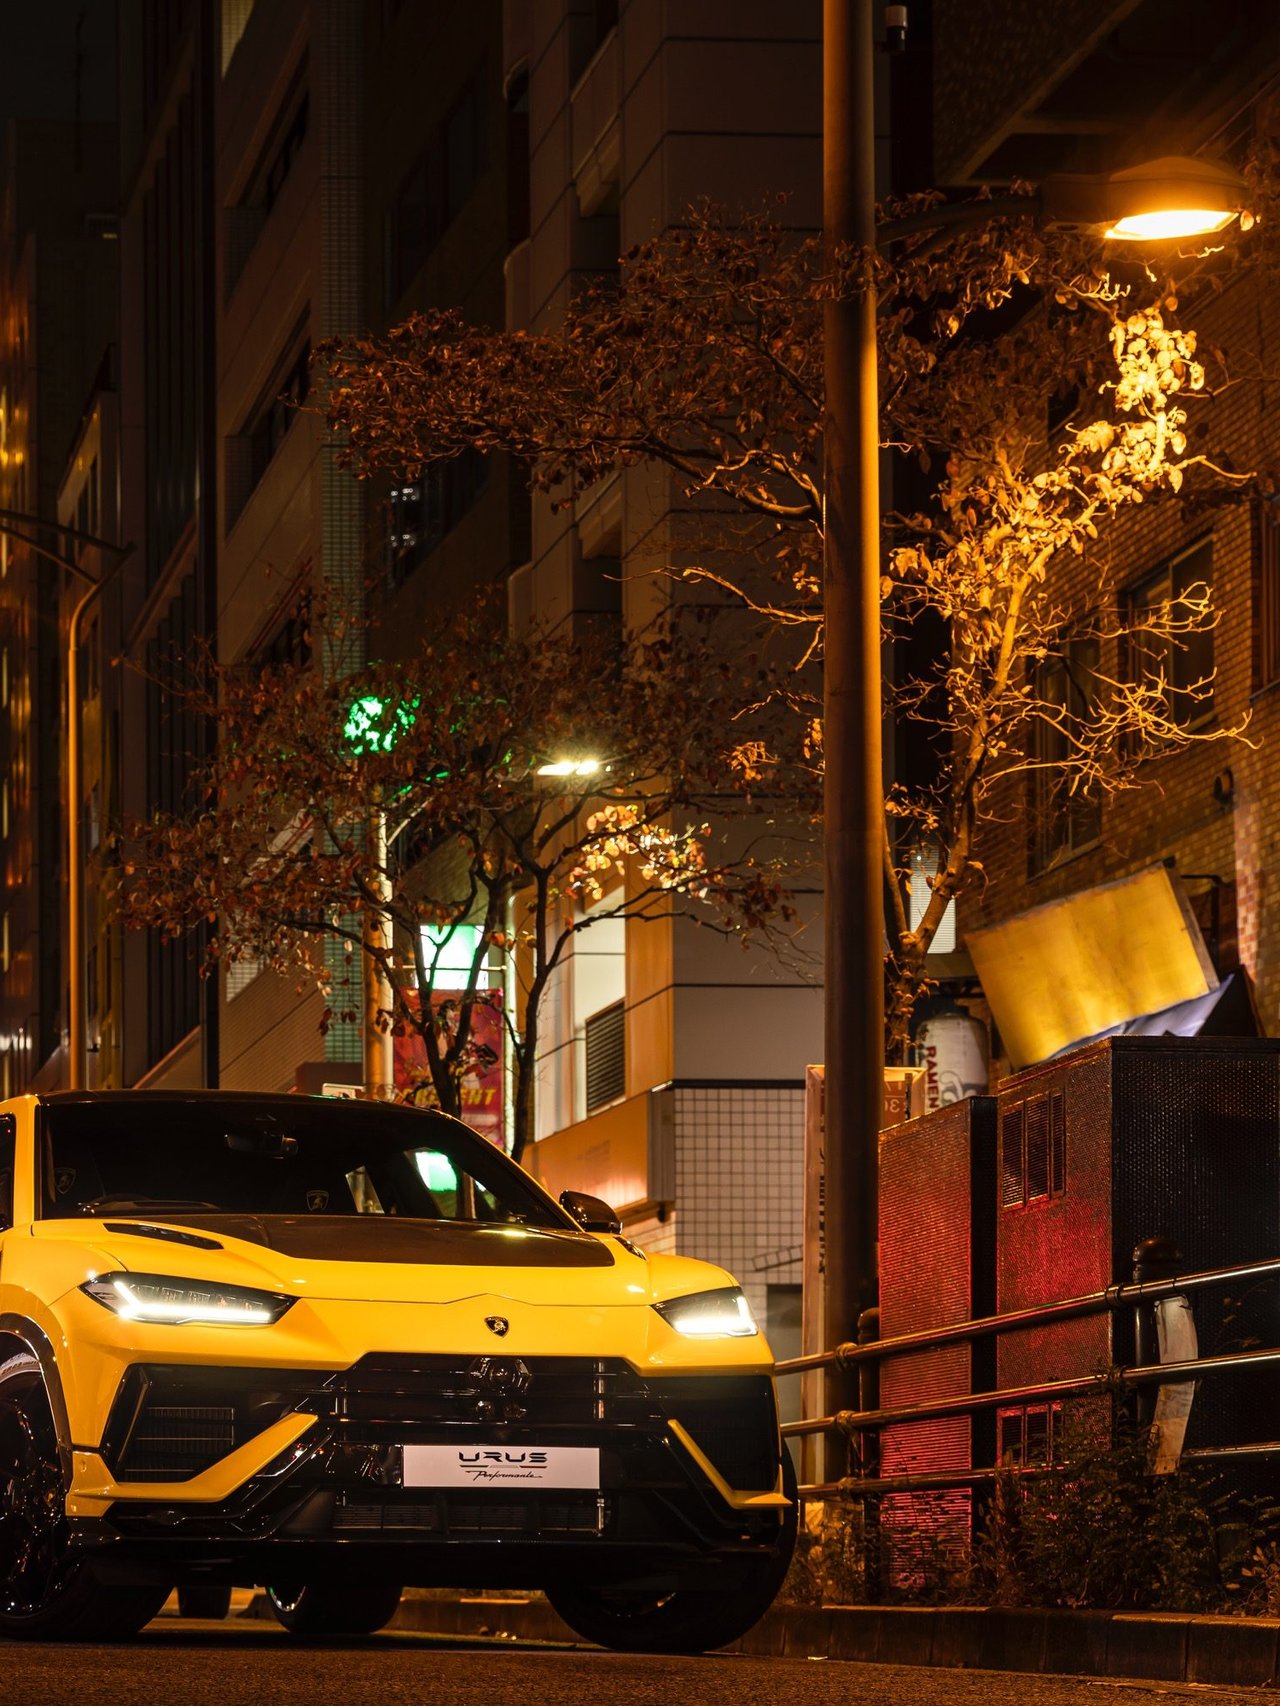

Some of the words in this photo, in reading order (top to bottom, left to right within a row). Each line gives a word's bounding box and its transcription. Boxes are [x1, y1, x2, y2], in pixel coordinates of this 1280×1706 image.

[926, 1046, 940, 1108] RAMEN
[459, 1451, 548, 1463] URUS
[465, 1470, 543, 1481] Performante
